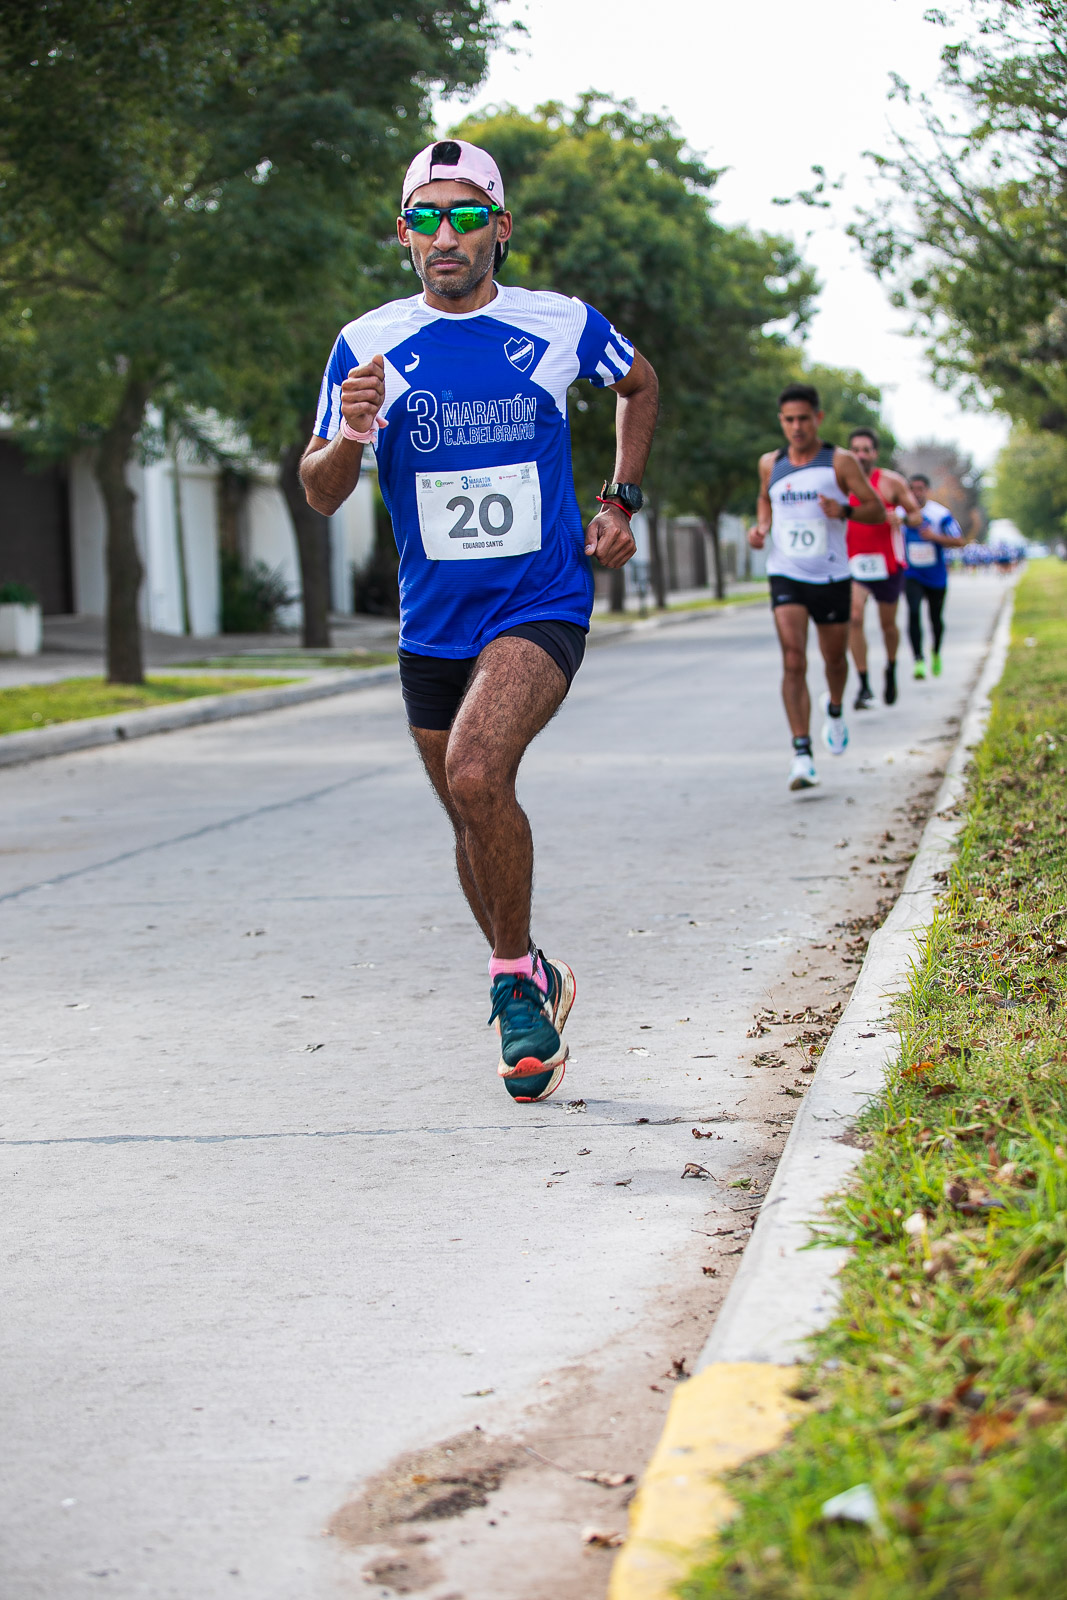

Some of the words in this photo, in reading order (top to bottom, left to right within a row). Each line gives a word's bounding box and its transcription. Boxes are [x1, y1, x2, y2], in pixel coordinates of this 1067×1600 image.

[407, 390, 440, 452] 3
[442, 393, 537, 427] MARATÓN
[460, 476, 469, 490] 3
[446, 494, 513, 538] 20
[462, 541, 485, 549] EDUARDO
[486, 540, 504, 548] SANTIS
[789, 530, 815, 548] 70
